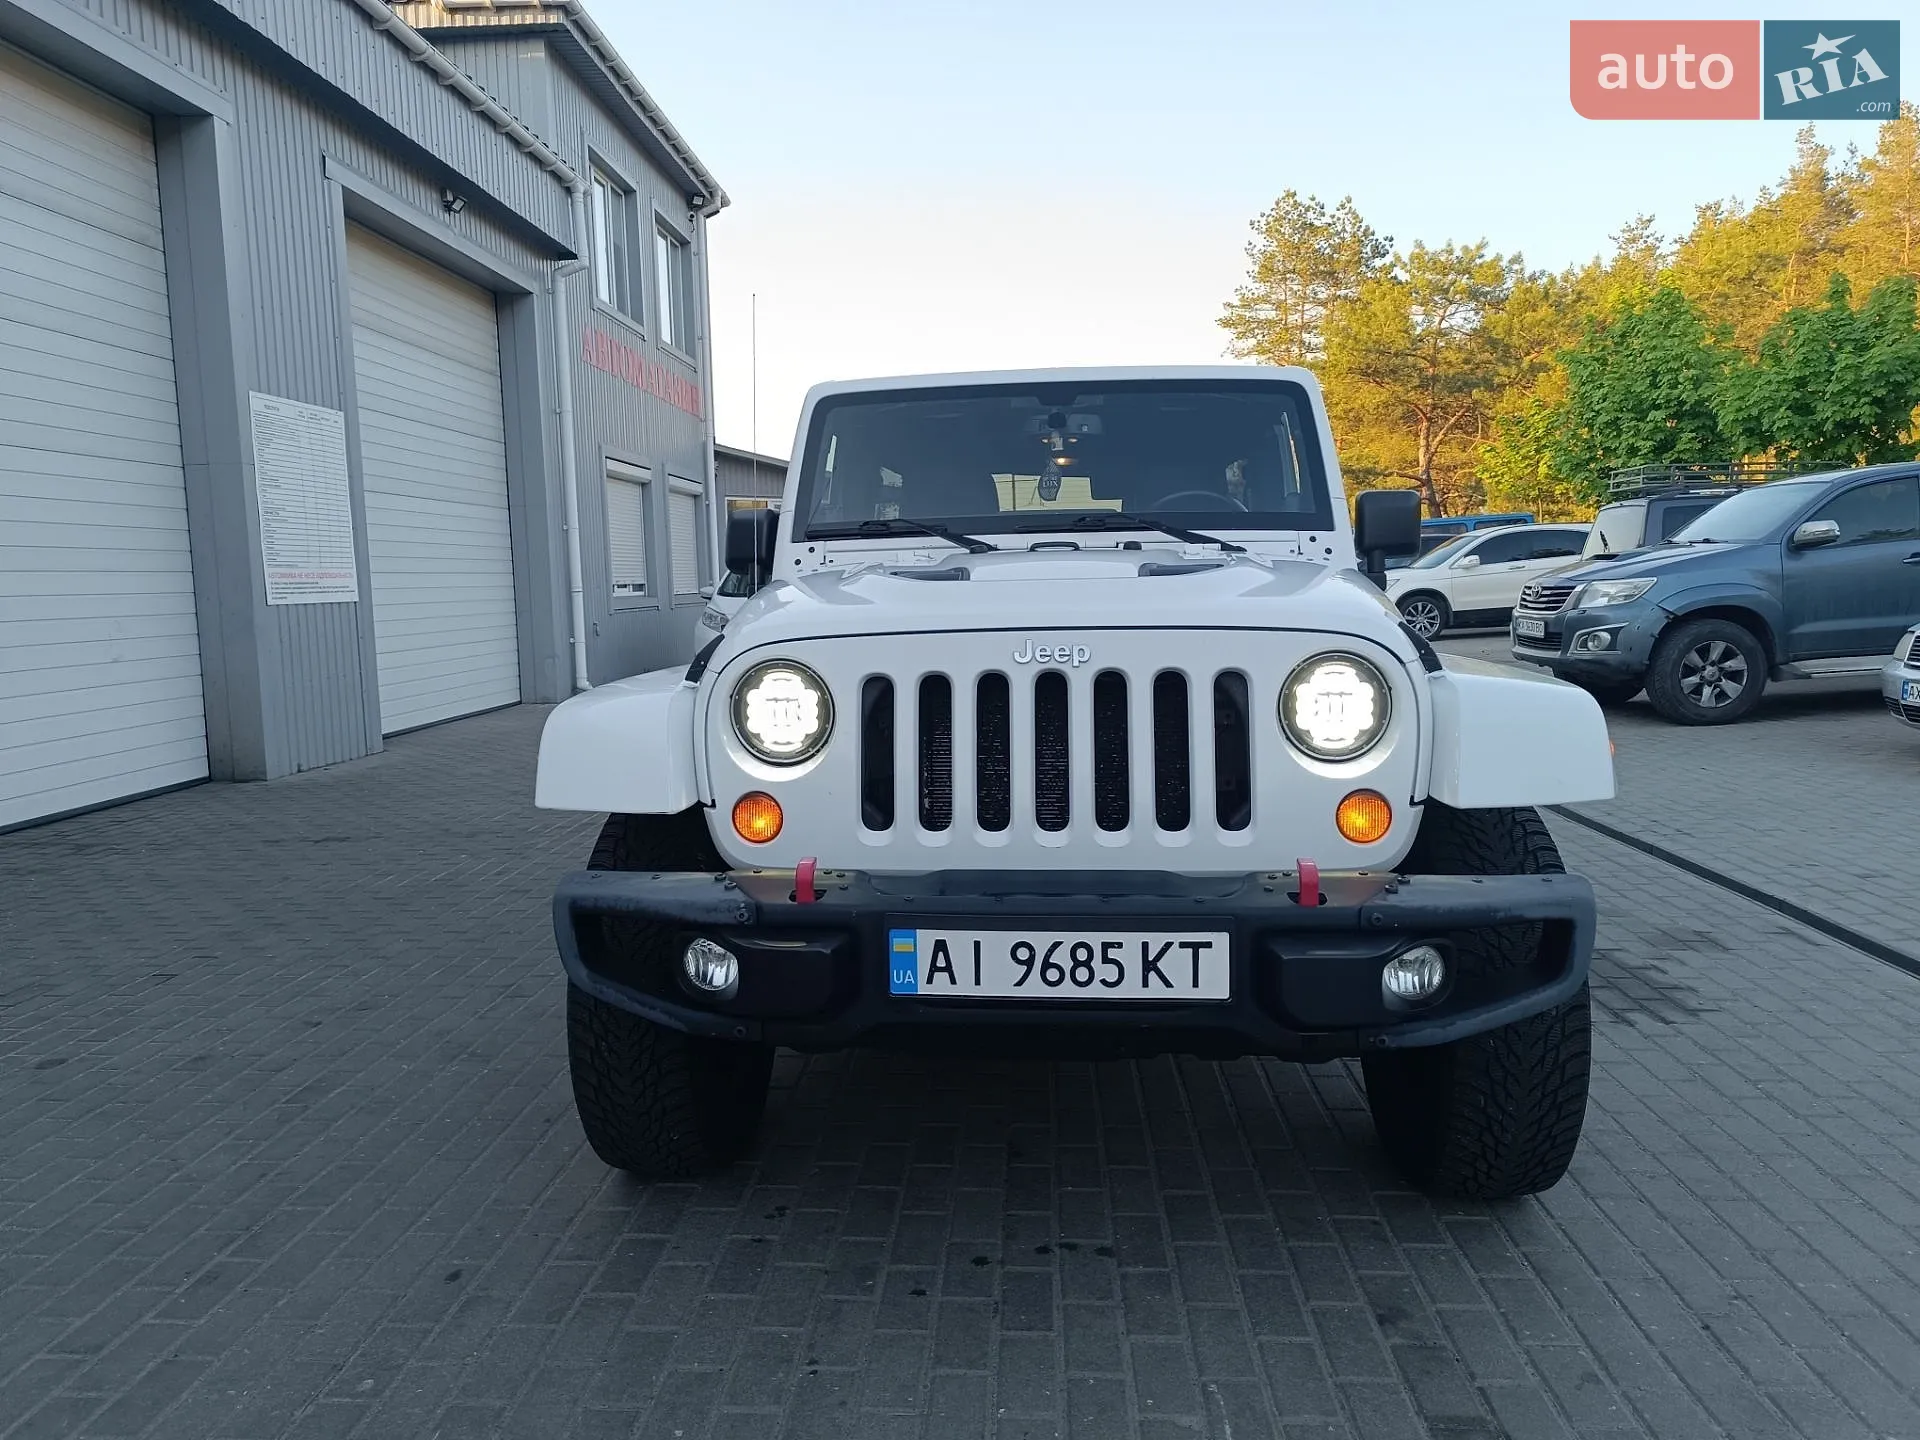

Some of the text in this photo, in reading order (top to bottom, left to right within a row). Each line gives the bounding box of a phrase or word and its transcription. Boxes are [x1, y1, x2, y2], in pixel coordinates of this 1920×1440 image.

[1013, 638, 1091, 668] Jeep
[893, 970, 915, 984] UA
[925, 938, 1214, 989] AI 9685 KT
